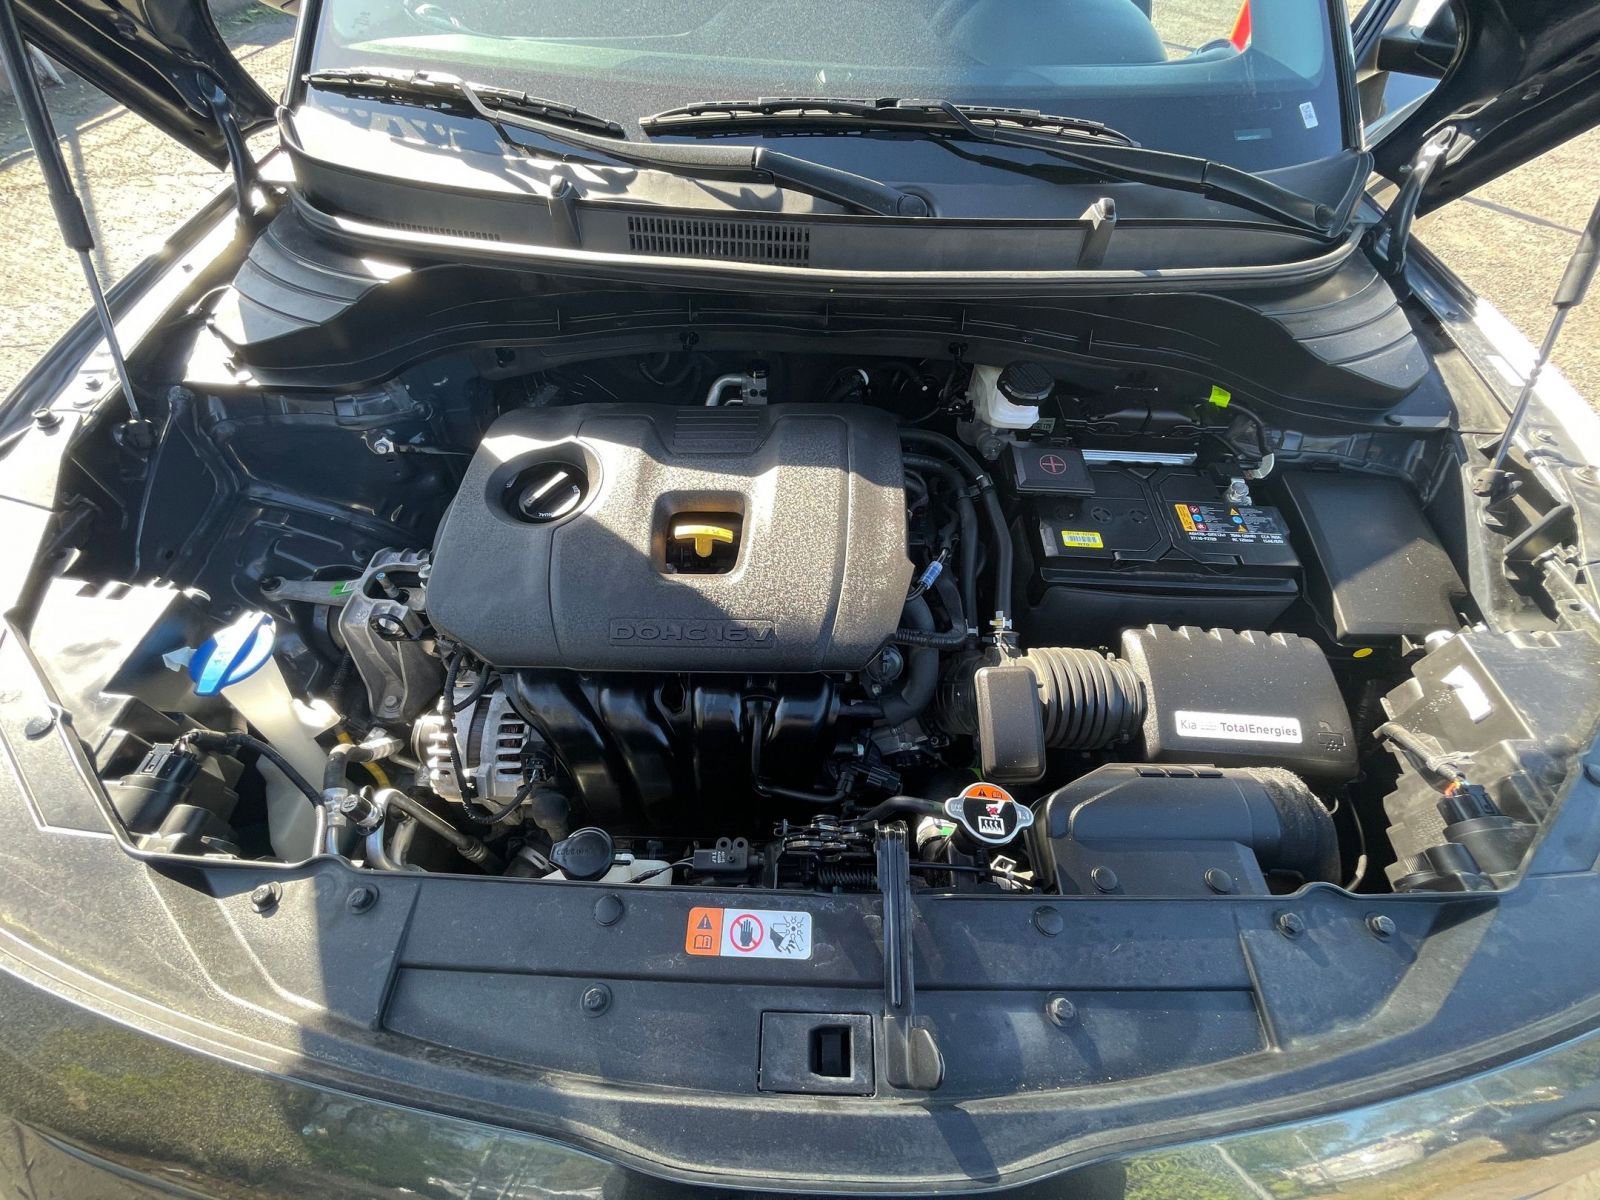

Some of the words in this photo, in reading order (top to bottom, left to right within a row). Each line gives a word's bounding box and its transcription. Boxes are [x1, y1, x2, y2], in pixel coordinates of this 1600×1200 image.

[611, 623, 708, 641] DOHC
[714, 624, 773, 642] 16V
[1180, 720, 1197, 730] Kia
[1220, 722, 1298, 737] TotalEnergies
